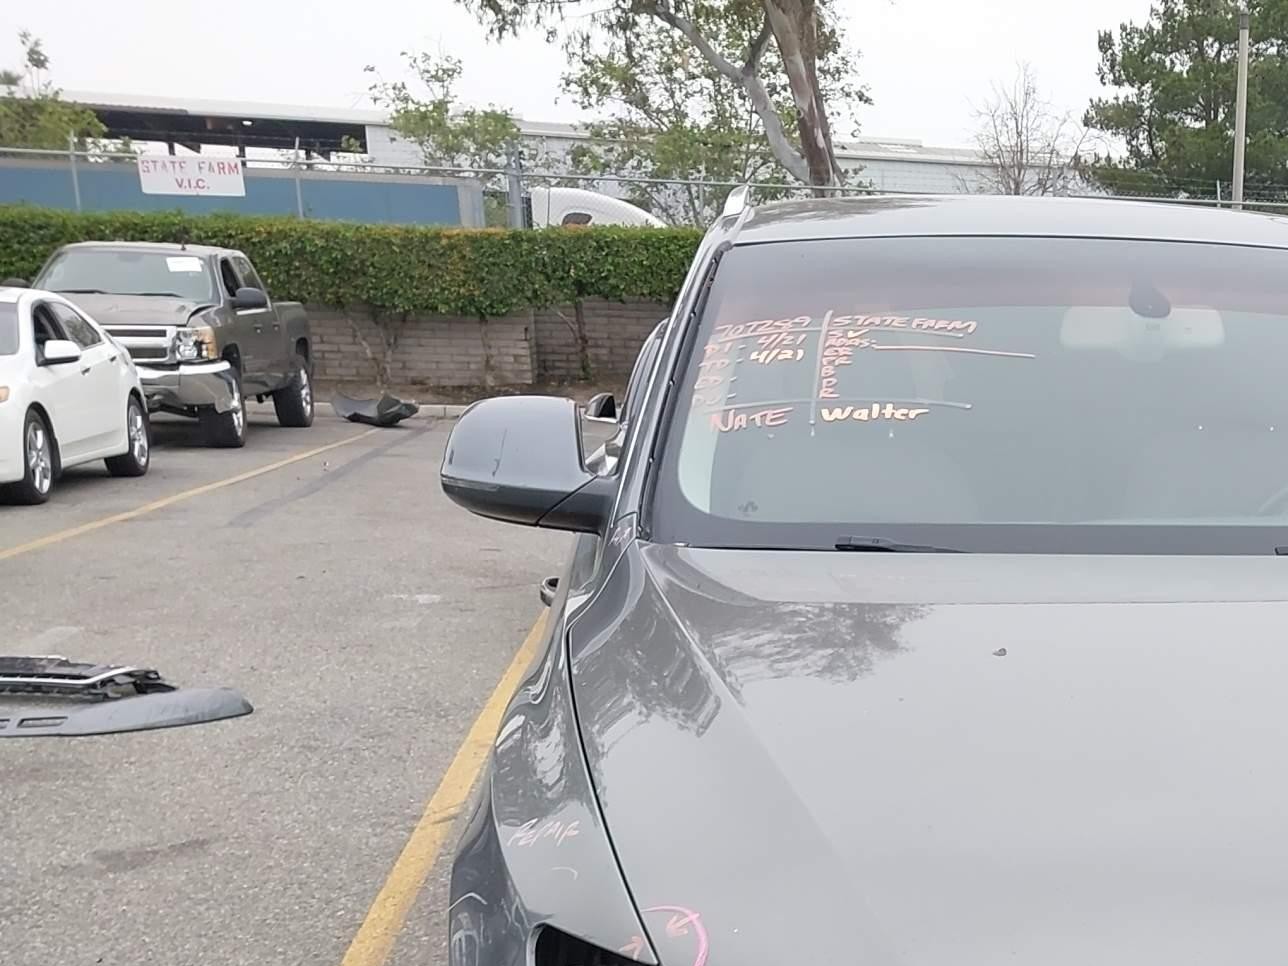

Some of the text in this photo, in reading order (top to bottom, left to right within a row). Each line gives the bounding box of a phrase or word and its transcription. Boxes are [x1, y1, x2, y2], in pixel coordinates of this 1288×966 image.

[140, 159, 240, 176] STATE FARM
[175, 178, 210, 190] V.I.C.
[832, 314, 978, 333] STATE FARM
[750, 348, 805, 365] 4/21
[709, 406, 794, 432] NATE
[820, 402, 930, 422] Walter
